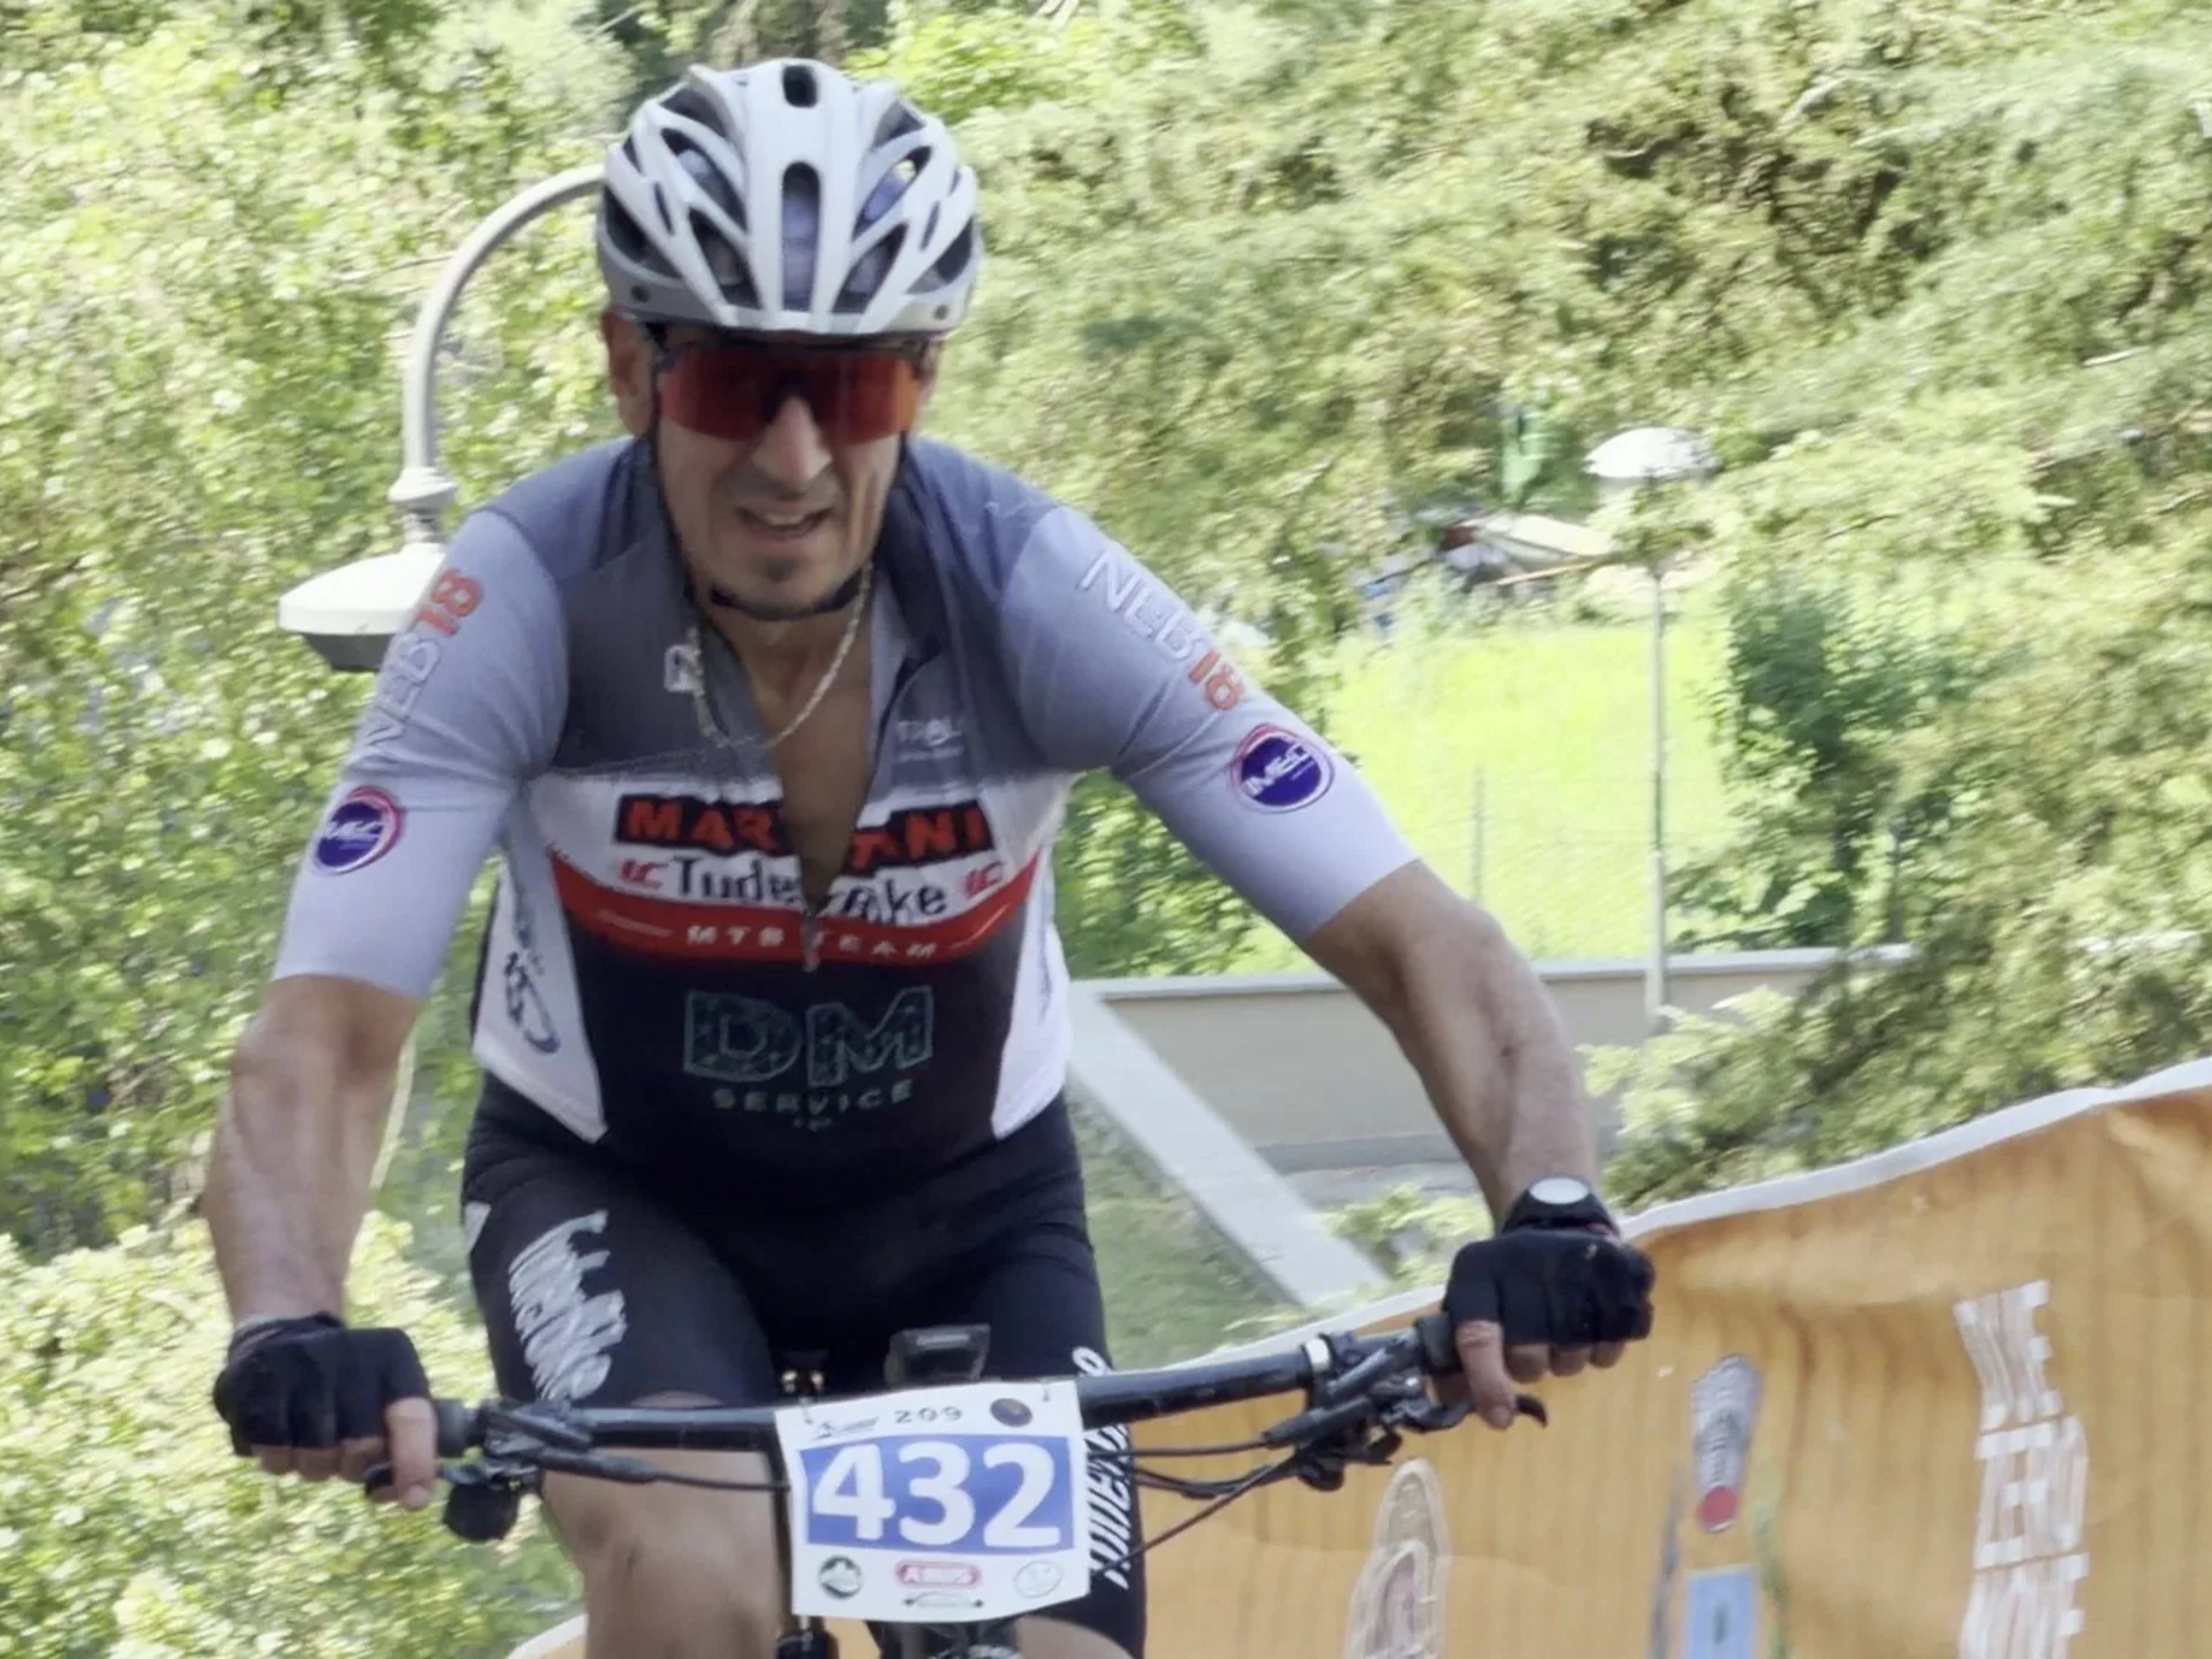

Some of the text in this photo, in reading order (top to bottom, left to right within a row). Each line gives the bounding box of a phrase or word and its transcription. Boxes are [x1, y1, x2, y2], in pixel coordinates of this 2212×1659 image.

[687, 925, 785, 947] MTB
[683, 984, 935, 1088] DM
[713, 1078, 914, 1115] SERVICE
[812, 1441, 1062, 1546] 432
